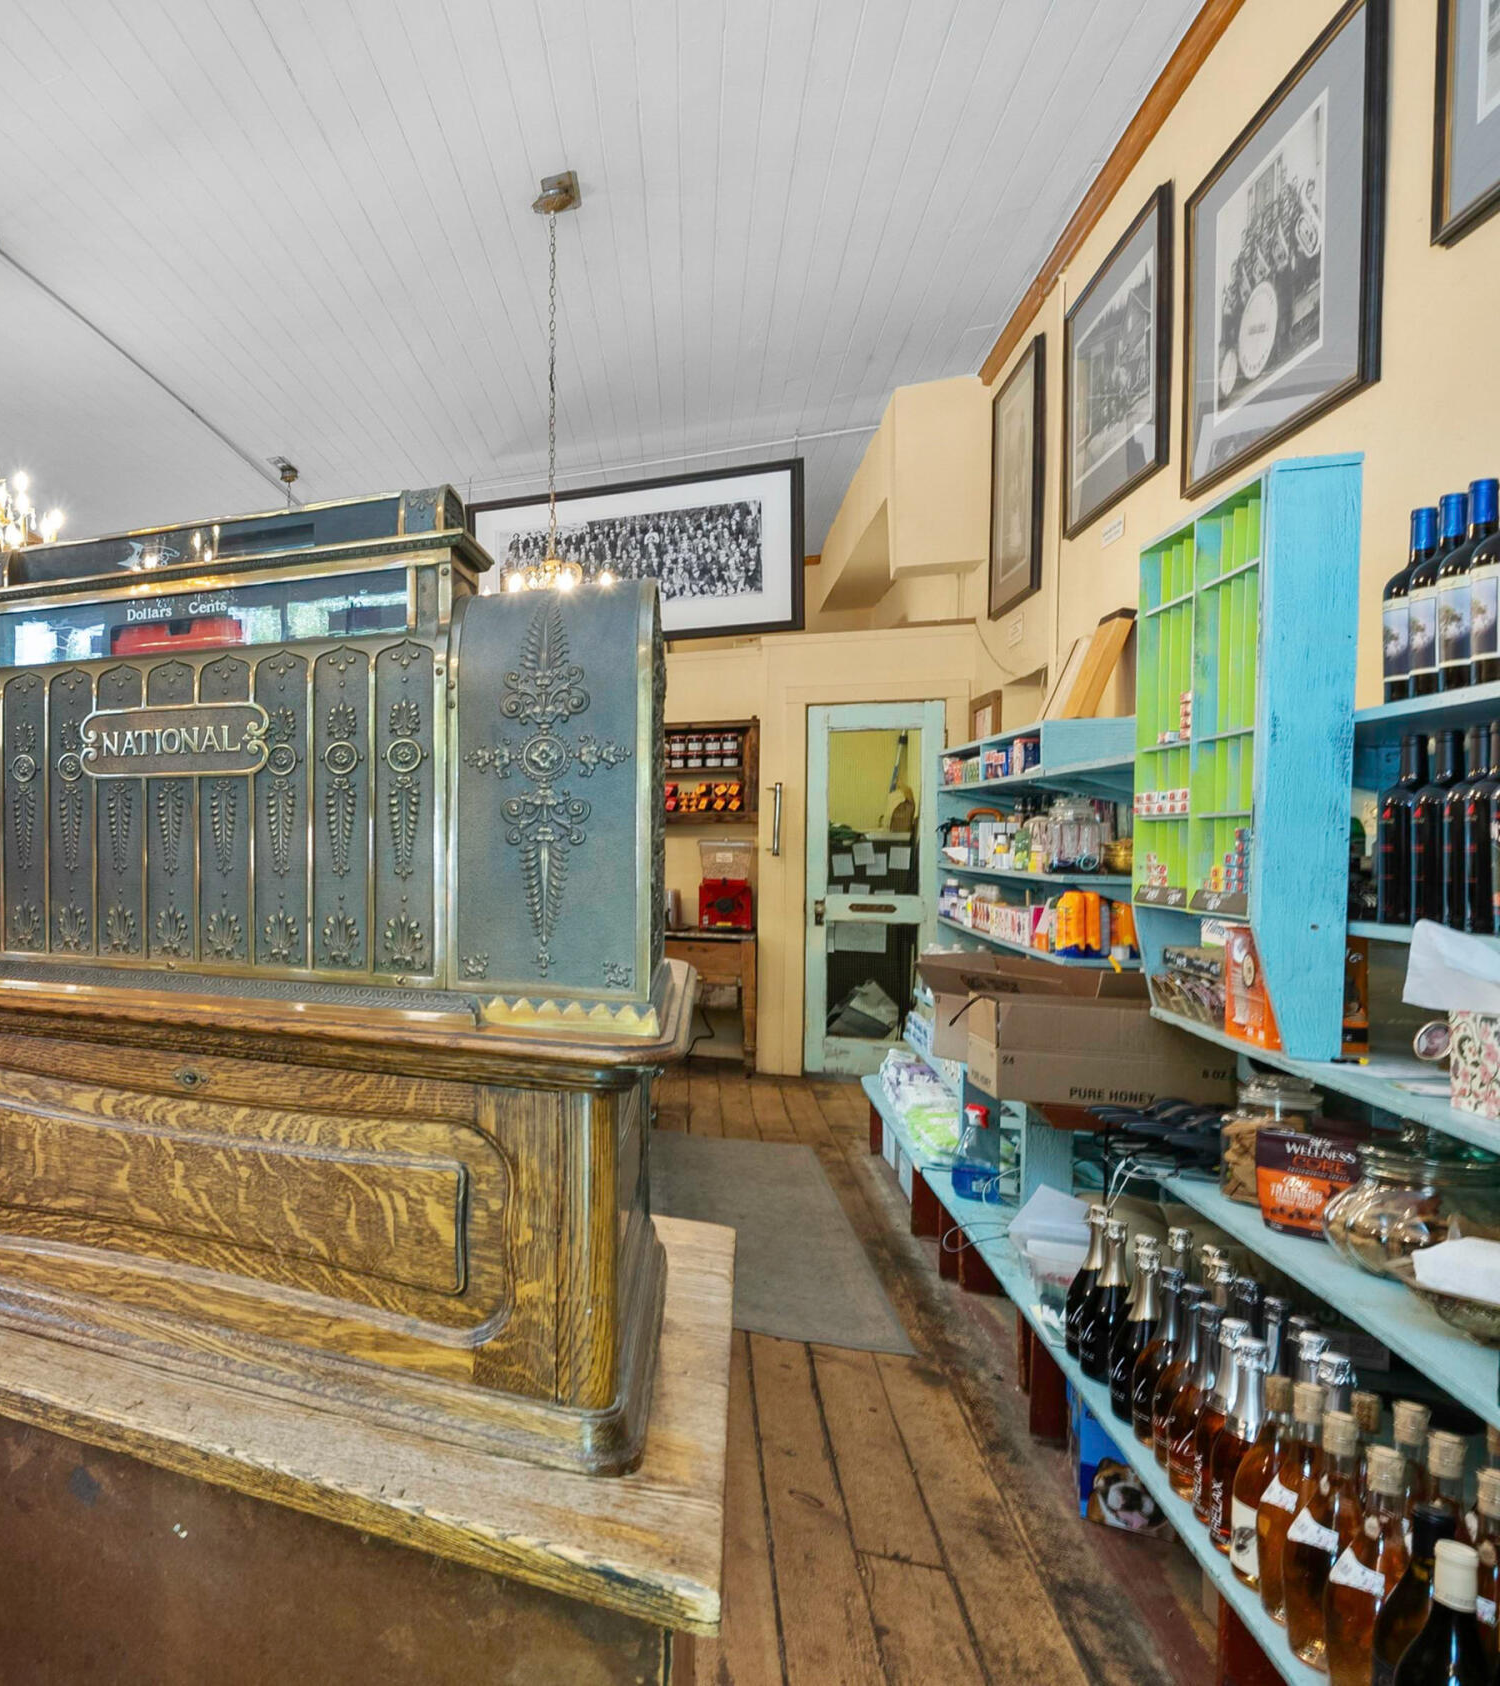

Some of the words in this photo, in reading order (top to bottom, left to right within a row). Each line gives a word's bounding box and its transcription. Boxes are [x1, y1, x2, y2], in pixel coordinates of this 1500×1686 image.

[126, 605, 172, 621] Dollars
[189, 599, 228, 615] Cents
[101, 725, 241, 757] NATIONAL
[1069, 1086, 1105, 1100] PURE
[1108, 1089, 1156, 1104] HONEY
[1285, 1141, 1356, 1164] WELLNESS
[1292, 1155, 1347, 1174] CORE
